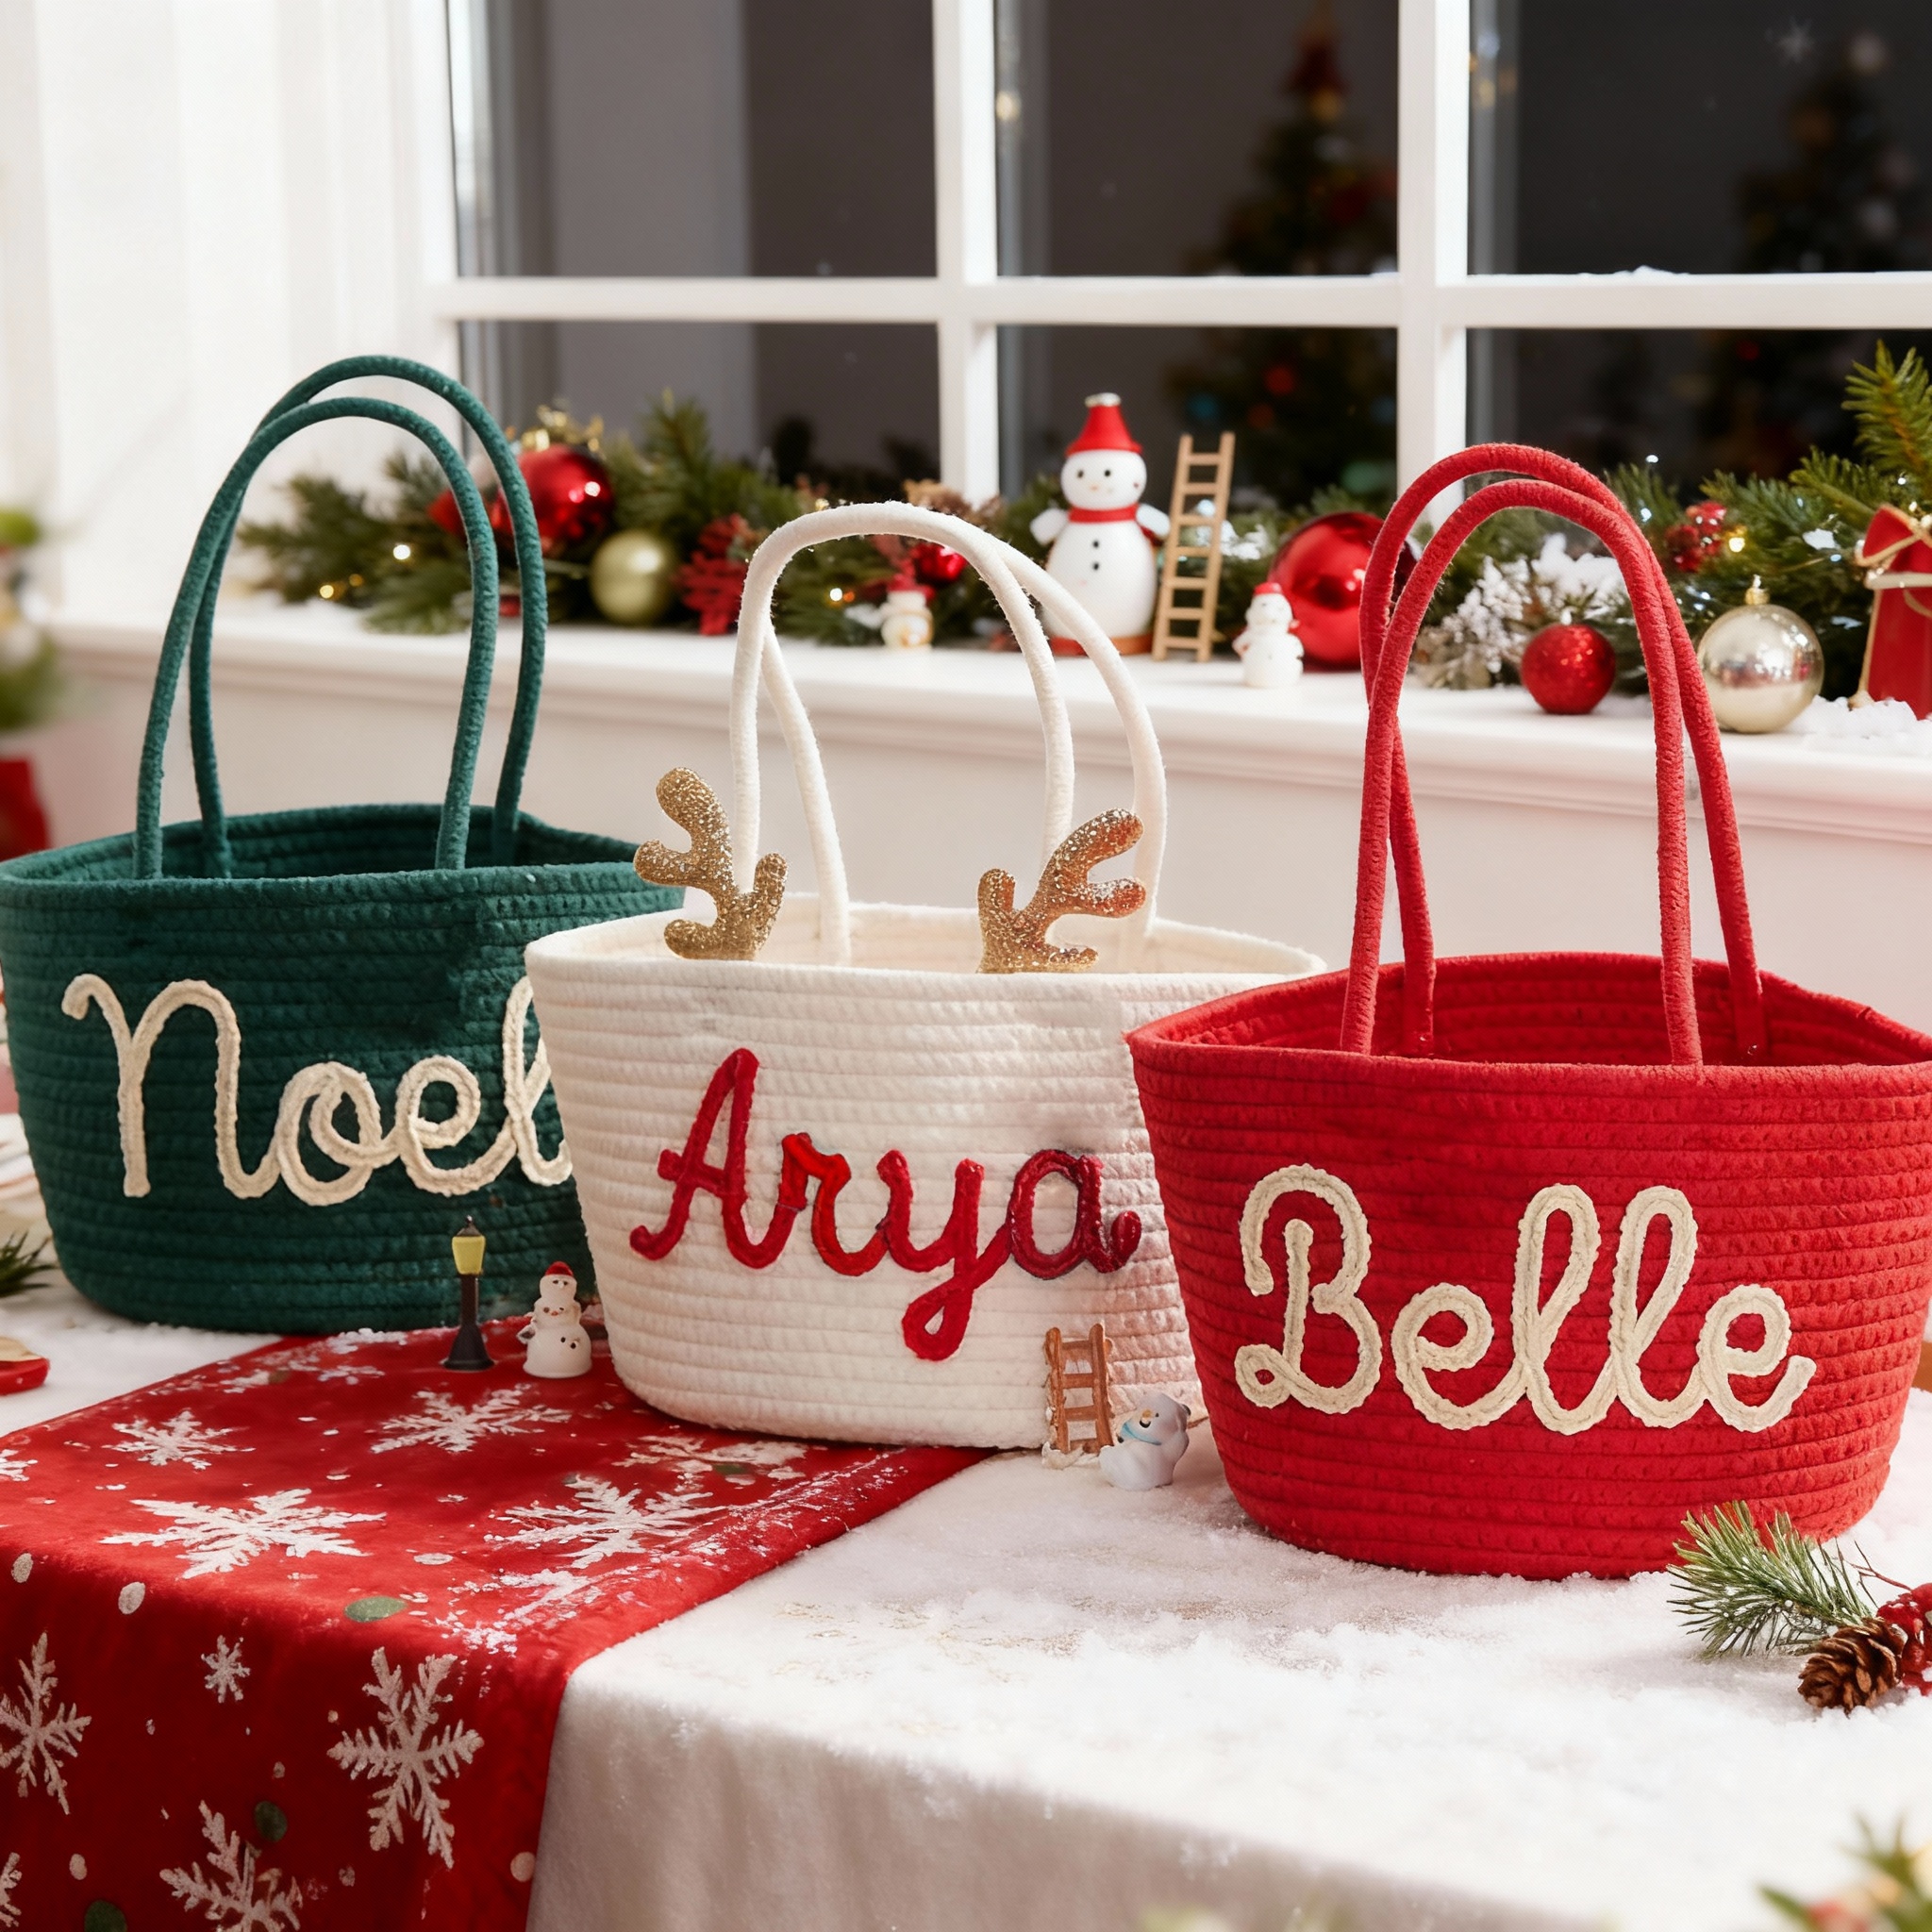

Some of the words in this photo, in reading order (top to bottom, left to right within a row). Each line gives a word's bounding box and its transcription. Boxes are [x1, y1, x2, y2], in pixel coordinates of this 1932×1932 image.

[61, 974, 573, 1207] Noel
[629, 1048, 1141, 1361] Arya
[1234, 1163, 1817, 1436] Belle
